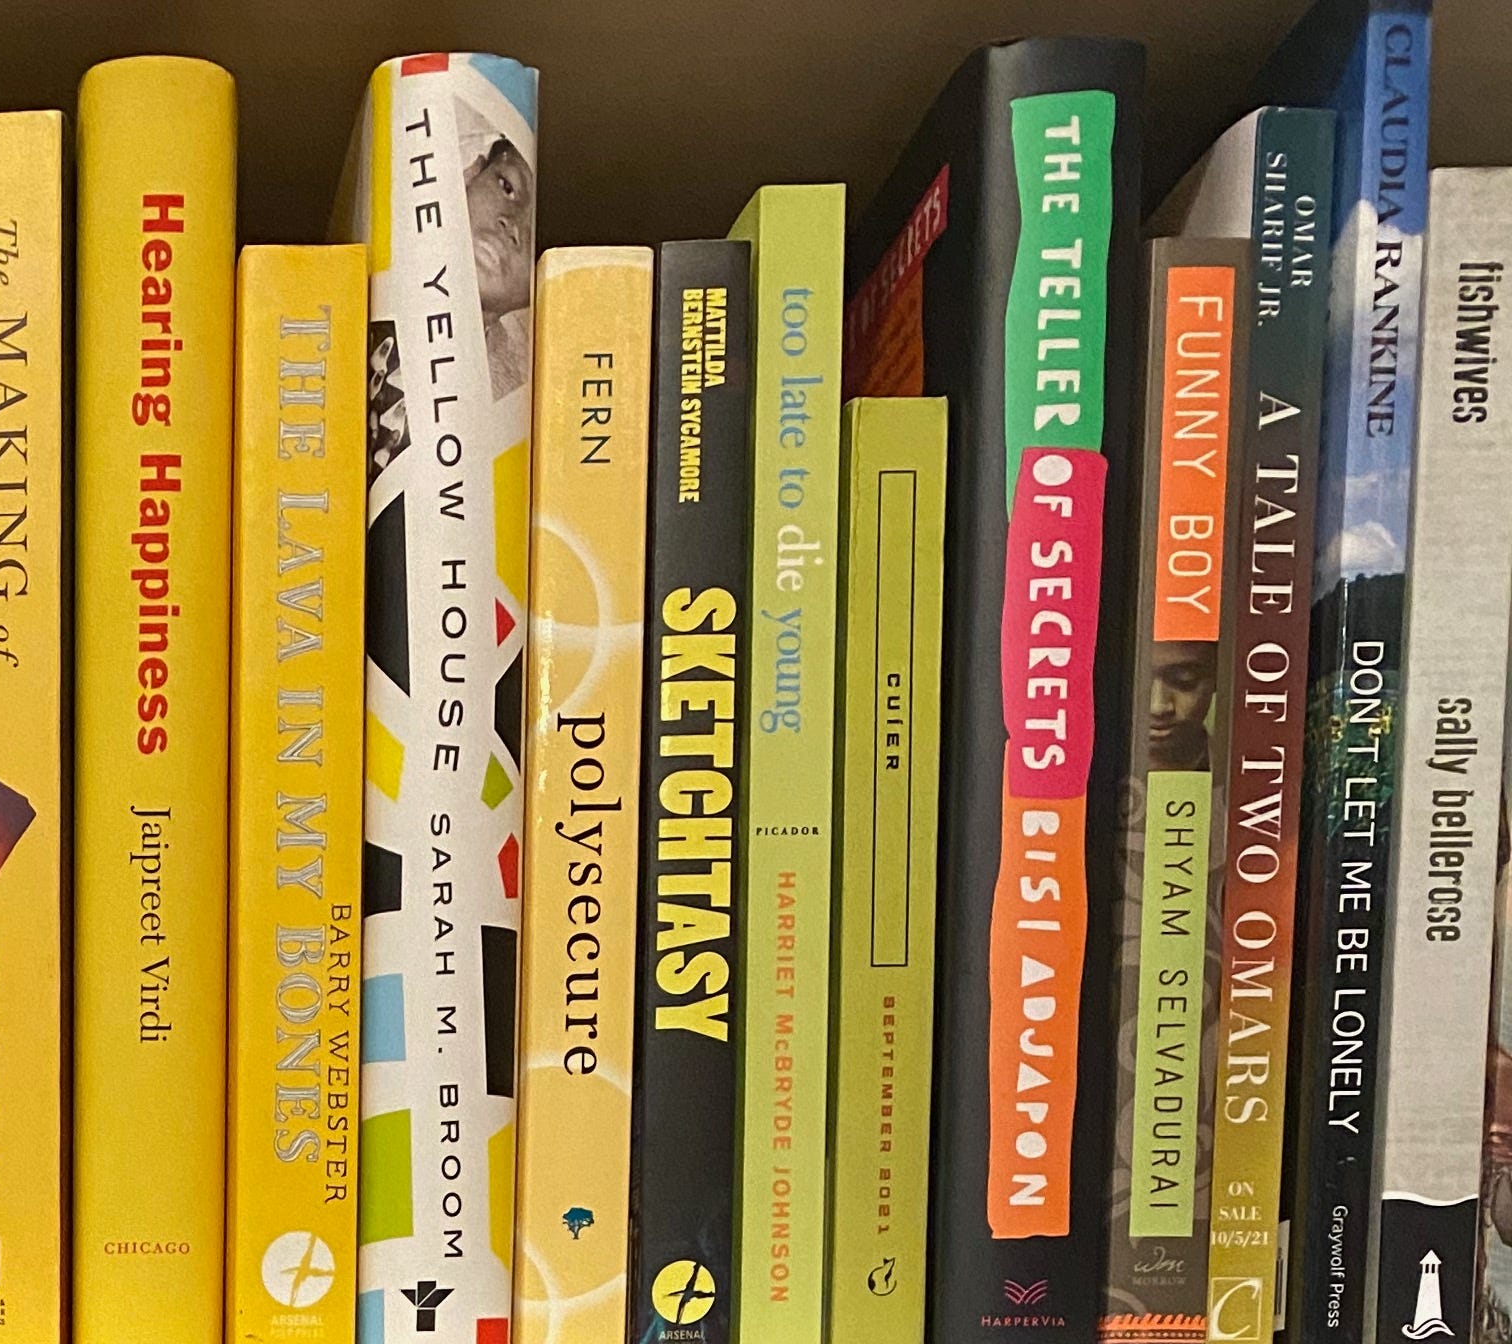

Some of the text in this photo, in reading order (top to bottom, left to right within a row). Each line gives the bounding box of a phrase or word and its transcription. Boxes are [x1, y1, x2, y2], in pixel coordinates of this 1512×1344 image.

[581, 352, 613, 465] FERN
[678, 289, 703, 503] BERNSTEIN SYCAMORE
[703, 287, 727, 388] MATTILDA
[131, 193, 185, 755] Hearing Happiness
[1166, 294, 1223, 616] FUNNY BOY
[554, 713, 622, 1077] polysecure
[653, 586, 739, 1042] SKETCHTASY
[756, 826, 820, 836] PICADOR
[1425, 696, 1478, 944] sally bellerose
[130, 805, 172, 1044] Jaipreet Virdi
[1009, 809, 1061, 1207] BISI ADJAPON
[1149, 799, 1195, 1210] SHYAM SELVADURAI
[104, 1241, 190, 1255] CHICAGO
[1211, 1231, 1269, 1245] 10/5/21
[1220, 1206, 1262, 1221] SALE
[1228, 1182, 1253, 1196] ON
[1328, 1206, 1349, 1328] Graywolf Press
